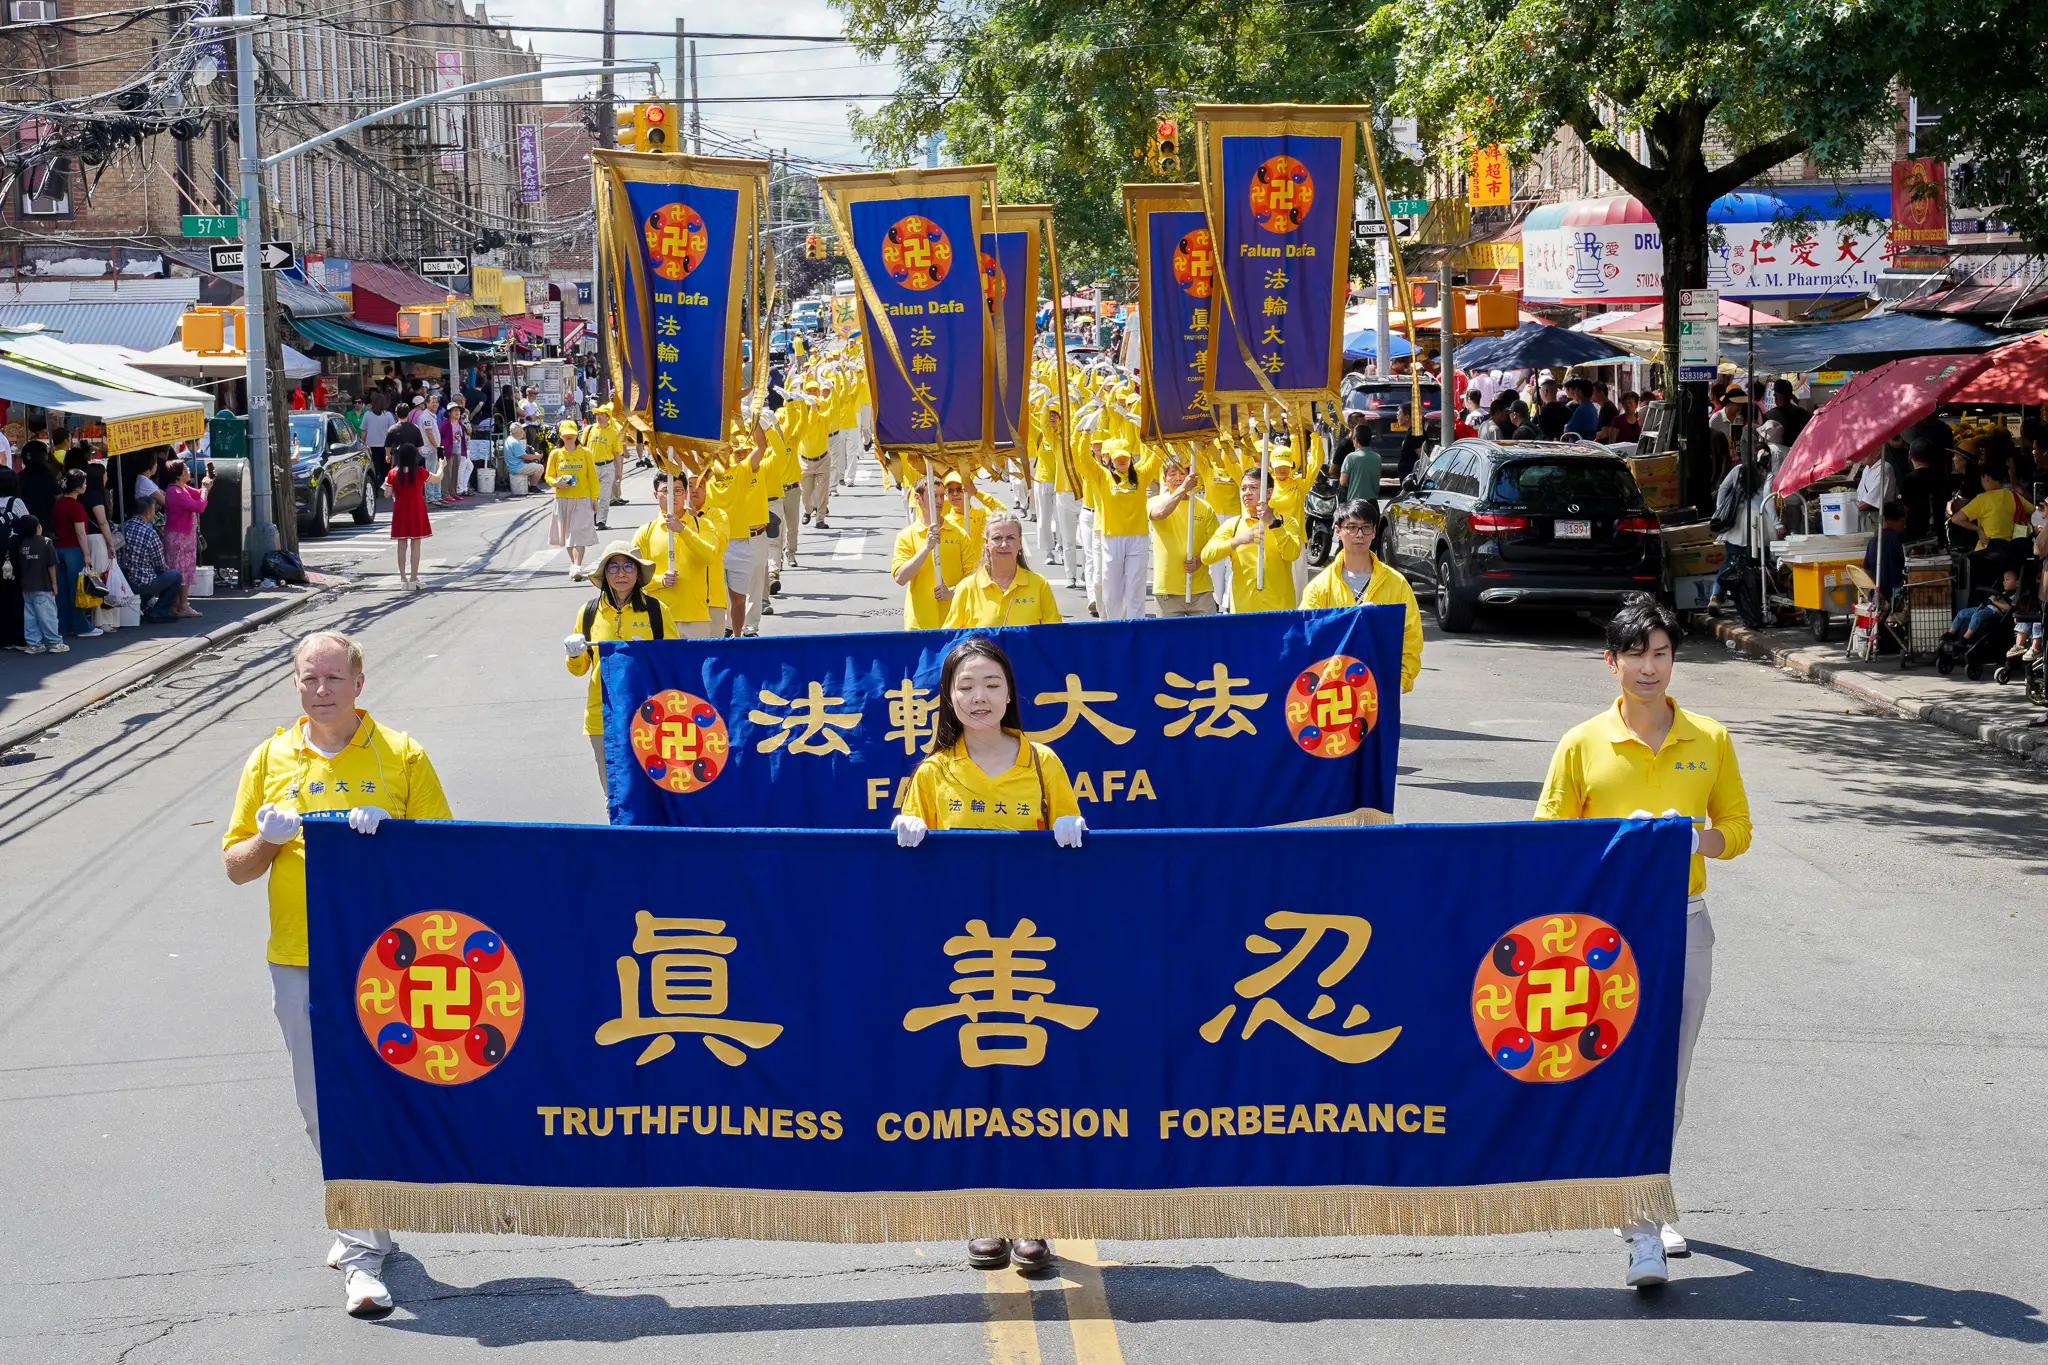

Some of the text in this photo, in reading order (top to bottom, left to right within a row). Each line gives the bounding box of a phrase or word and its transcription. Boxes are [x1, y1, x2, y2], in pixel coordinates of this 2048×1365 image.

[1398, 202, 1408, 213] 57
[197, 218, 225, 234] 57 St
[1361, 225, 1376, 233] ONE
[1240, 243, 1316, 257] Falun Dafa
[219, 253, 242, 264] ONE
[427, 262, 461, 271] ONE WAY
[1746, 274, 1760, 287] A.
[1766, 273, 1782, 286] M.
[1788, 271, 1859, 288] Pharmacy,
[678, 292, 709, 305] Dafa
[836, 302, 855, 323] 法
[928, 300, 965, 314] Dafa
[1260, 267, 1289, 373] 法輪大法
[1682, 322, 1689, 334] 2
[657, 315, 681, 419] 法輪大法
[911, 325, 937, 429] 法輪大法
[1680, 371, 1704, 380] 338318
[749, 663, 1268, 754] 法輪大法
[285, 780, 376, 800] 法輪大法
[1073, 769, 1157, 803] AFA
[949, 798, 1031, 816] 法輪大法
[538, 1104, 1446, 1141] TRUTHFULNESS COMPASSION FORBEARANCE
